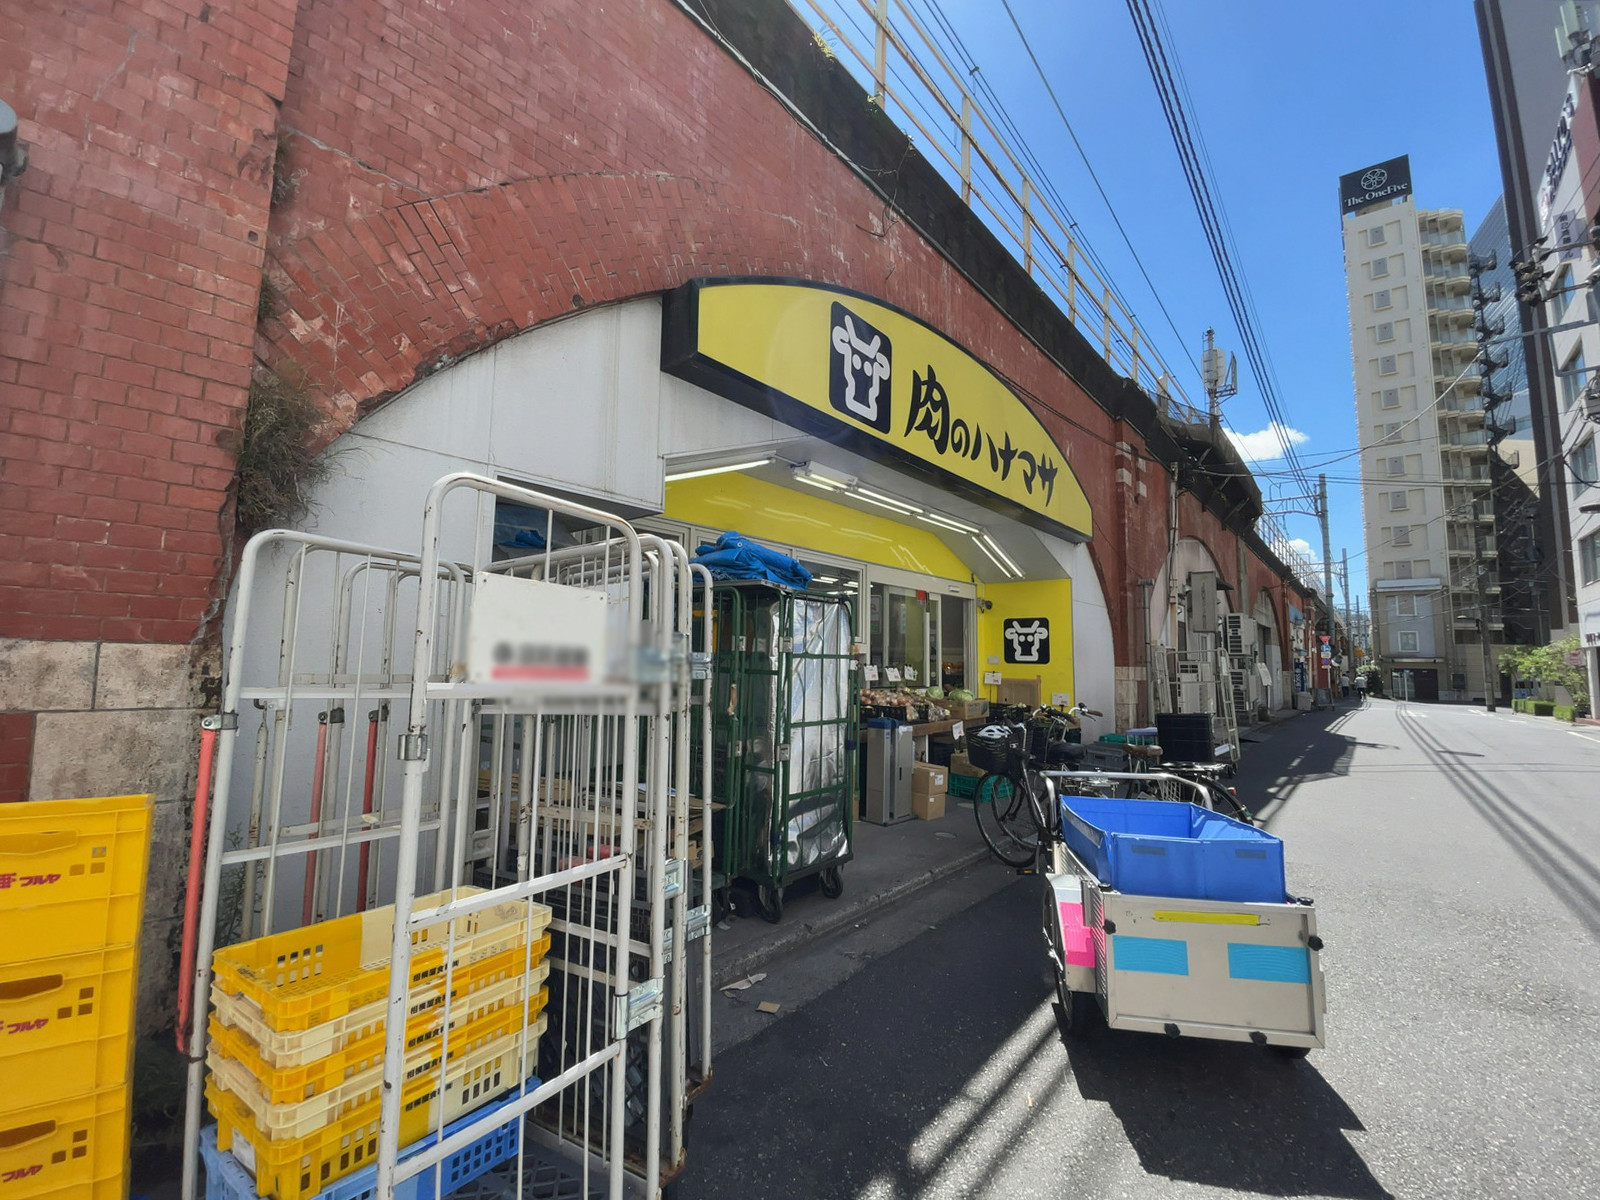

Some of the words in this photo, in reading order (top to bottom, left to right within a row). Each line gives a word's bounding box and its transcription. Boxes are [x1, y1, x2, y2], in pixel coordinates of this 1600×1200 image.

[1344, 196, 1364, 207] The
[1365, 183, 1408, 200] OneFive
[905, 364, 1059, 507] 肉のハナマサ
[0, 1018, 49, 1035] フルヤ
[1, 1164, 43, 1183] フルヤ
